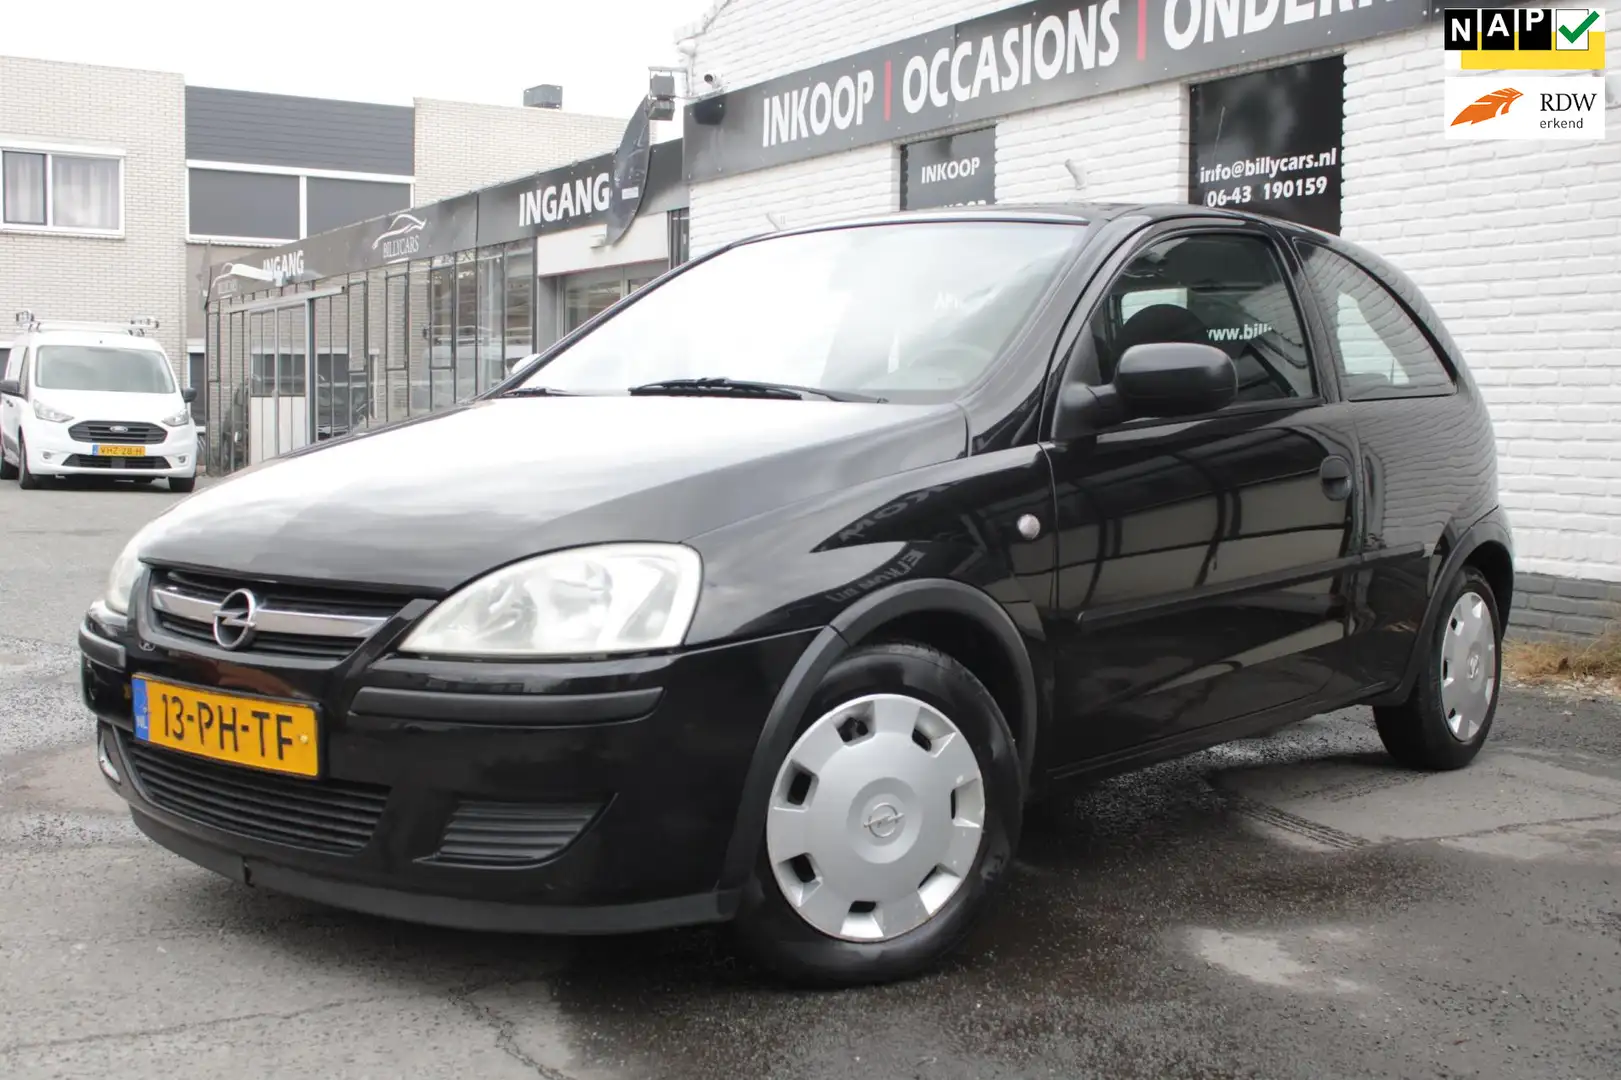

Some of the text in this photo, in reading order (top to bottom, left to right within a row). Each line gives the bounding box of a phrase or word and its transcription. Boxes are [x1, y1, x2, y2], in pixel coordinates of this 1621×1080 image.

[763, 69, 874, 147] INKOOP
[902, 0, 1120, 114] OCCASIONS
[921, 156, 980, 184] INKOOP
[1200, 147, 1337, 183] info@billycars.nl
[518, 172, 610, 227] INGANG
[1206, 176, 1328, 208] 06-43 190159
[263, 250, 304, 278] INGANG
[162, 694, 293, 760] 13-PH-TF
